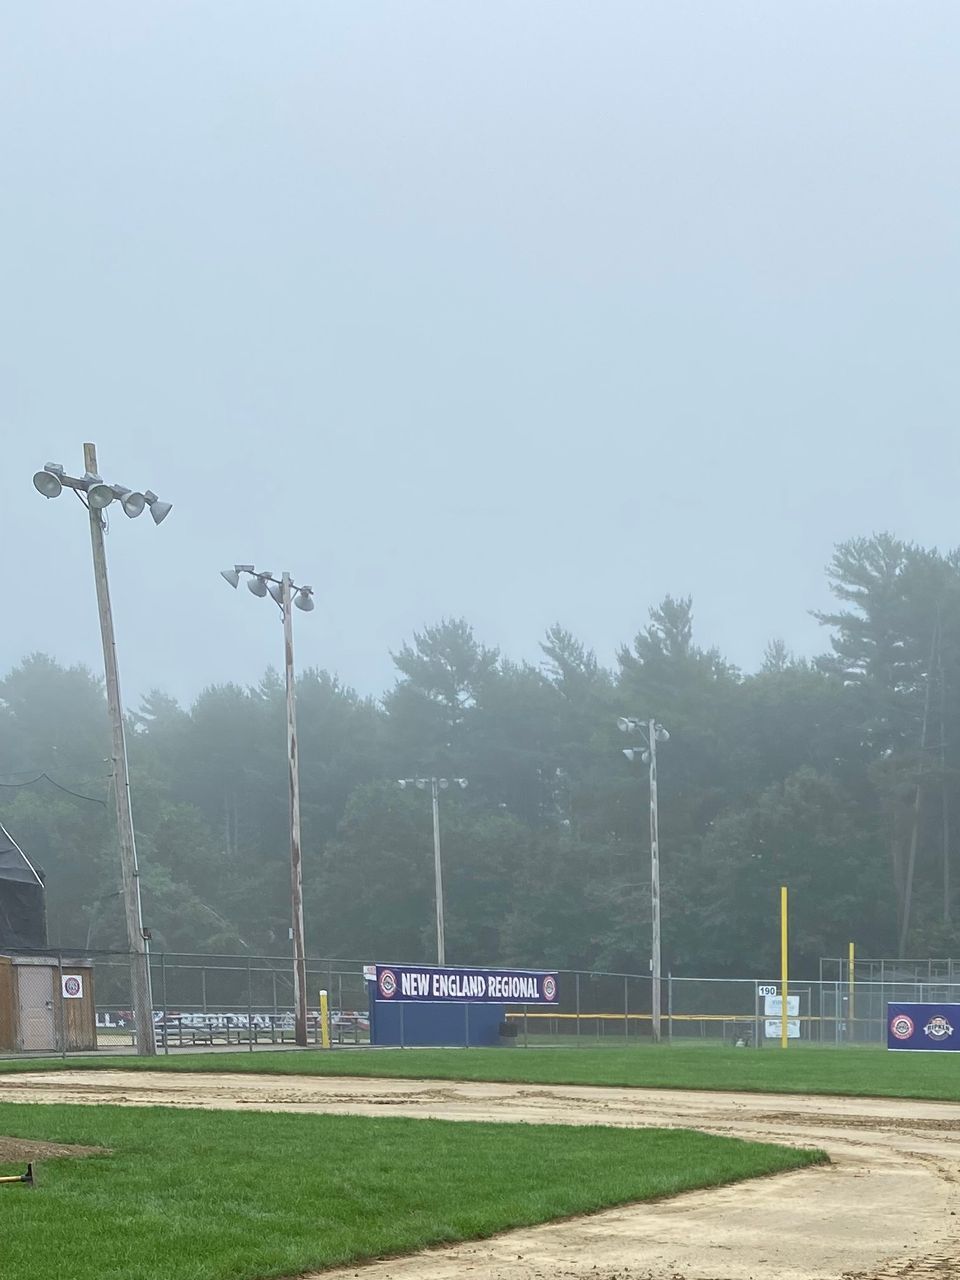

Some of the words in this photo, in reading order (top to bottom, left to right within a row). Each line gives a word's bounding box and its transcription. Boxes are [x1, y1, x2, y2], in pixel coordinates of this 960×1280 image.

[401, 972, 430, 996] NEW
[432, 973, 486, 997] ENGLAND
[488, 975, 540, 998] REGIONAL
[760, 987, 775, 995] 190
